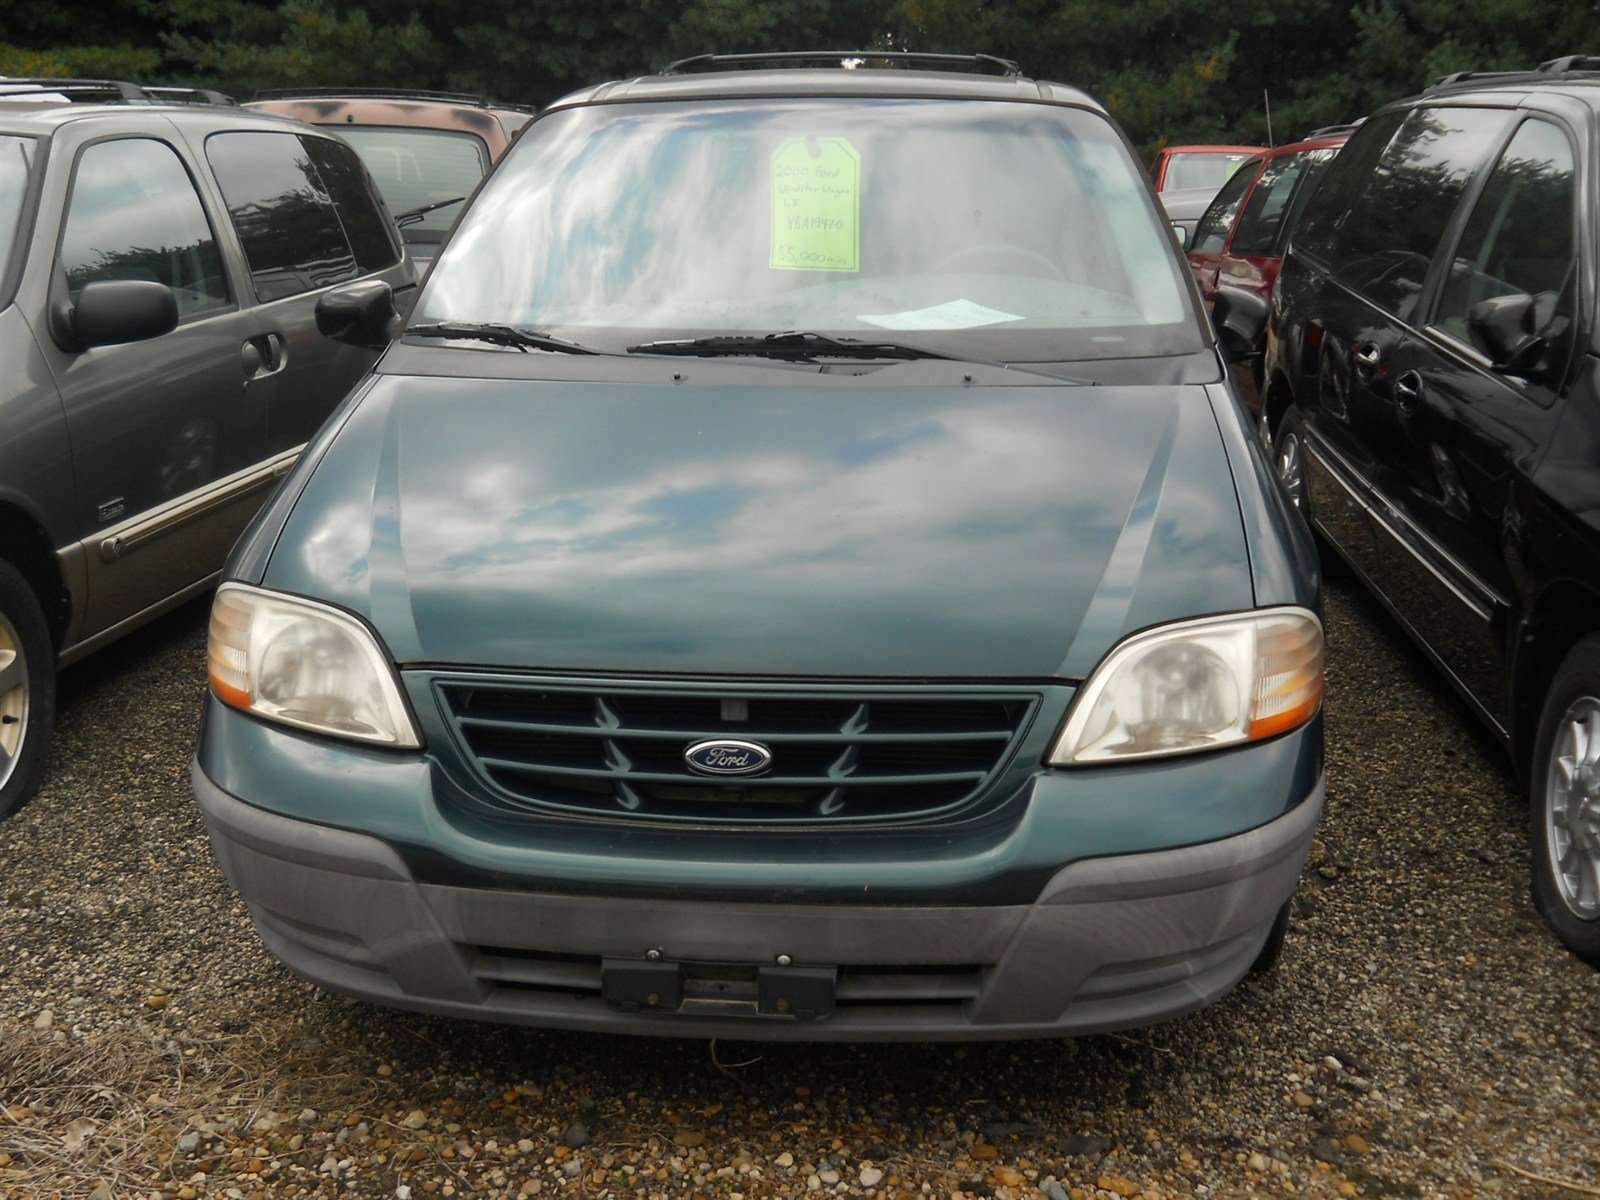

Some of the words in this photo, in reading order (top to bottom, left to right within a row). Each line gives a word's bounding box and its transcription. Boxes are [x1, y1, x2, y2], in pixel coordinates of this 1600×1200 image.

[776, 164, 809, 178] 2000
[815, 165, 840, 178] Ford
[783, 199, 800, 207] LX
[705, 747, 749, 767] Ford
